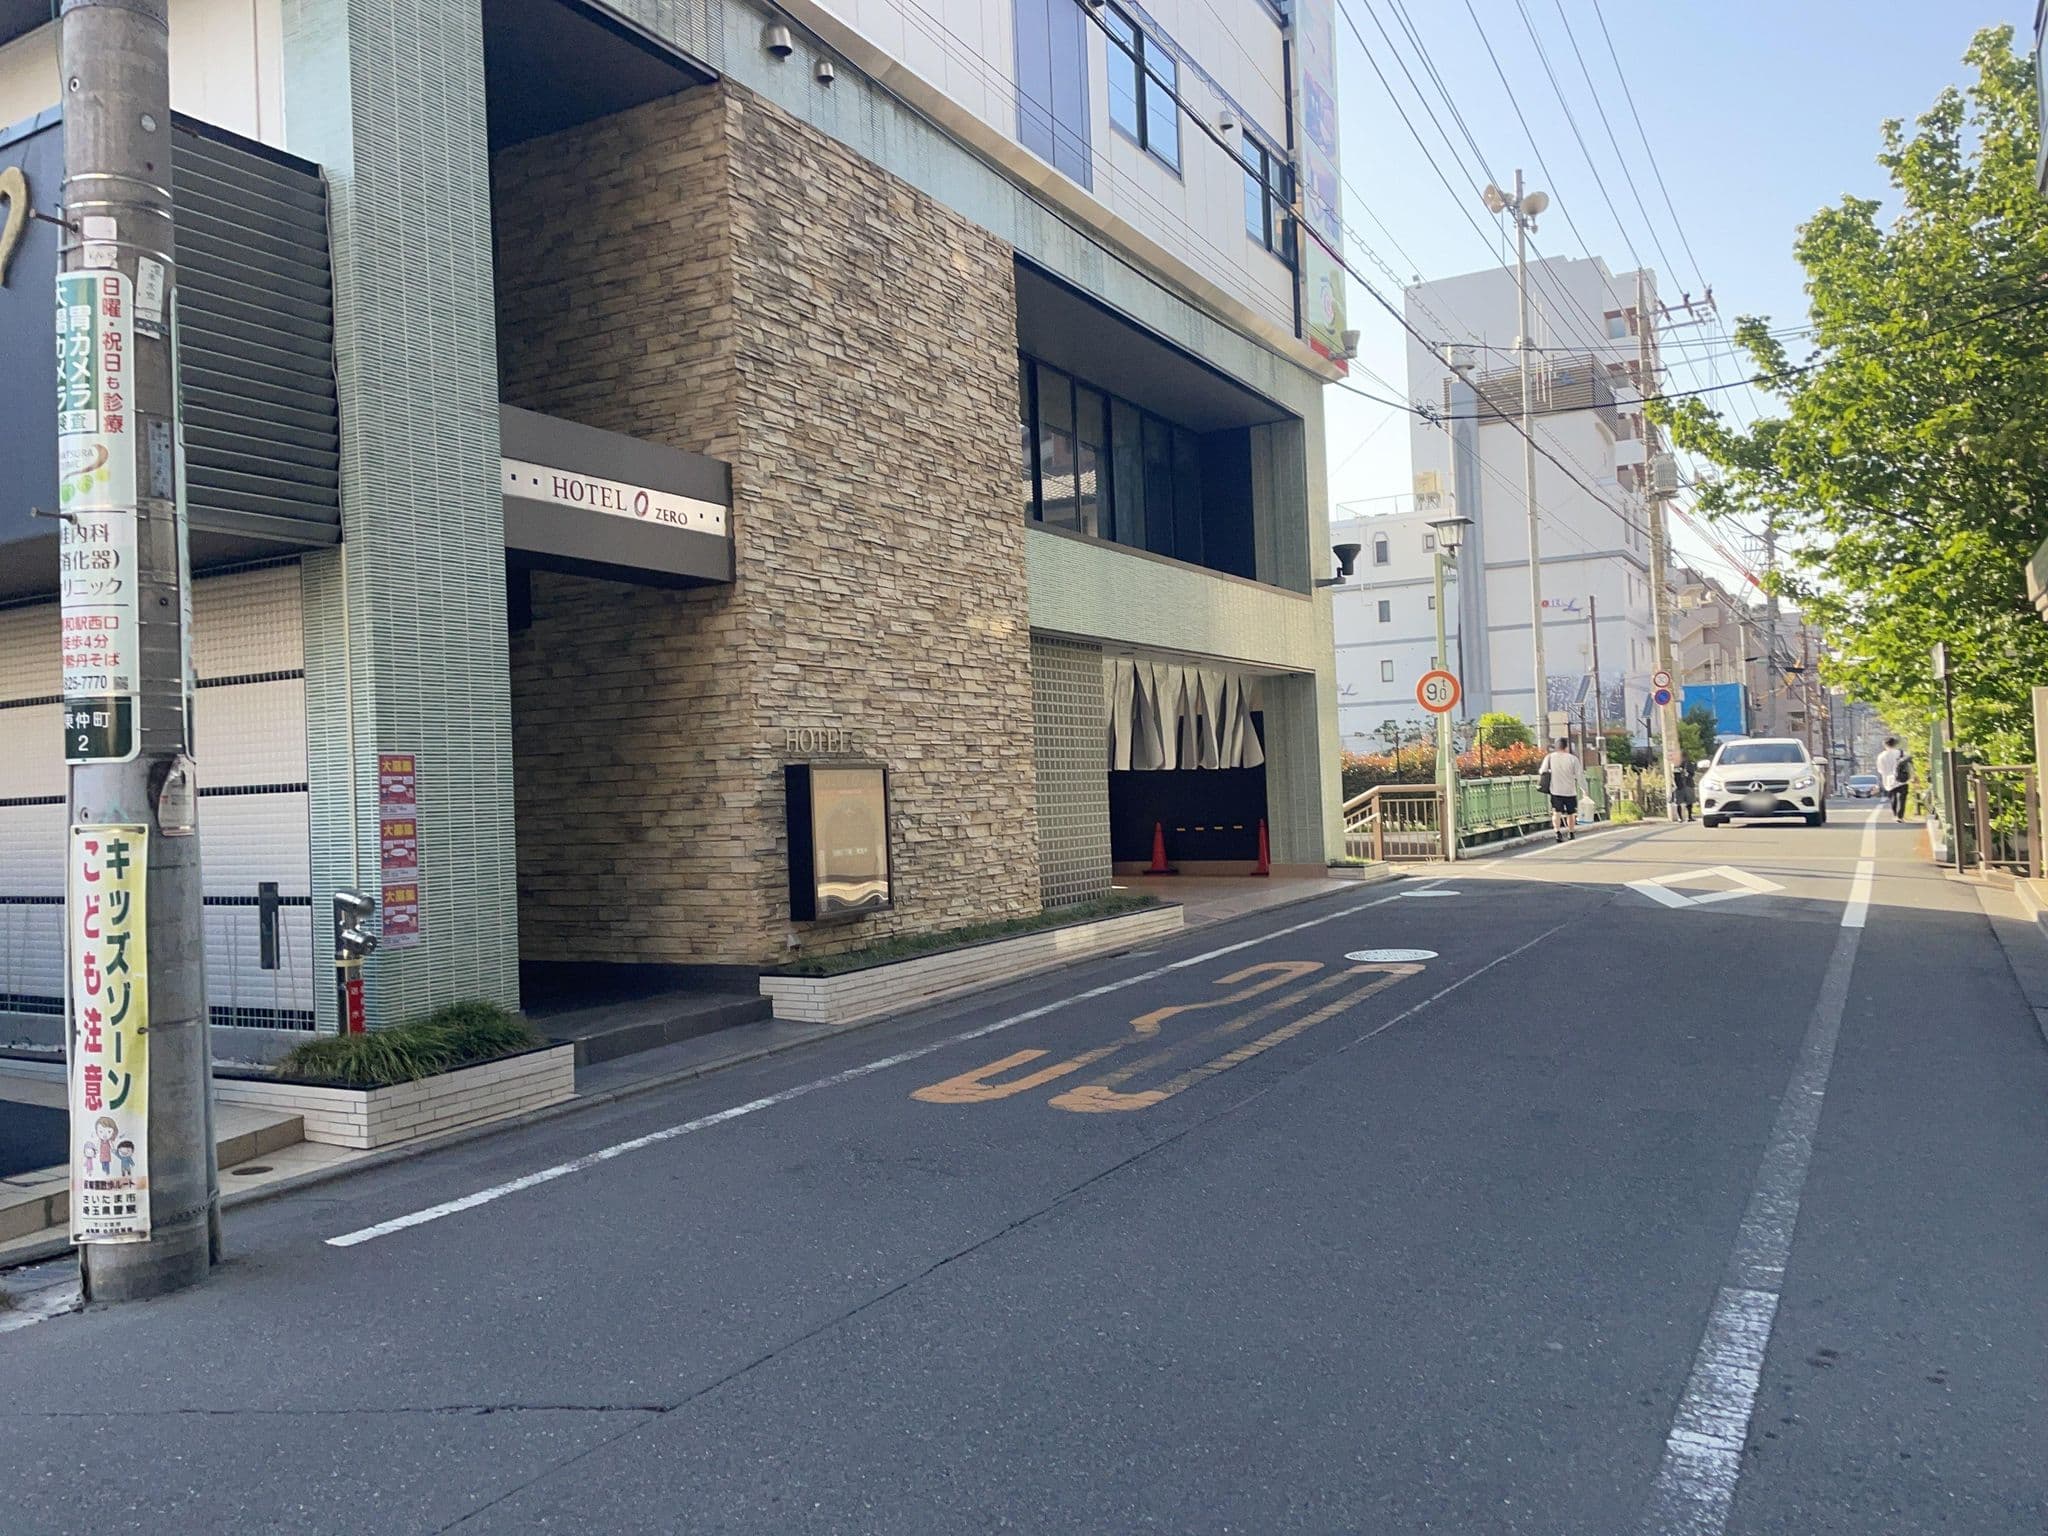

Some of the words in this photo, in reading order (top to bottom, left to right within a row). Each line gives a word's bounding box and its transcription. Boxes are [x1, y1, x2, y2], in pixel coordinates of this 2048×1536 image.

[69, 304, 92, 408] 胃カメラ
[102, 276, 124, 434] 日曜・祝日も診療
[552, 475, 628, 512] HOTEL
[655, 507, 688, 525] ZERO
[62, 616, 119, 630] 和駅西口
[64, 711, 111, 729] 東仲町
[78, 735, 89, 751] 2
[83, 840, 103, 1112] こども注意
[105, 838, 131, 1111] キッズゾーン
[83, 1193, 137, 1205] さいたま市
